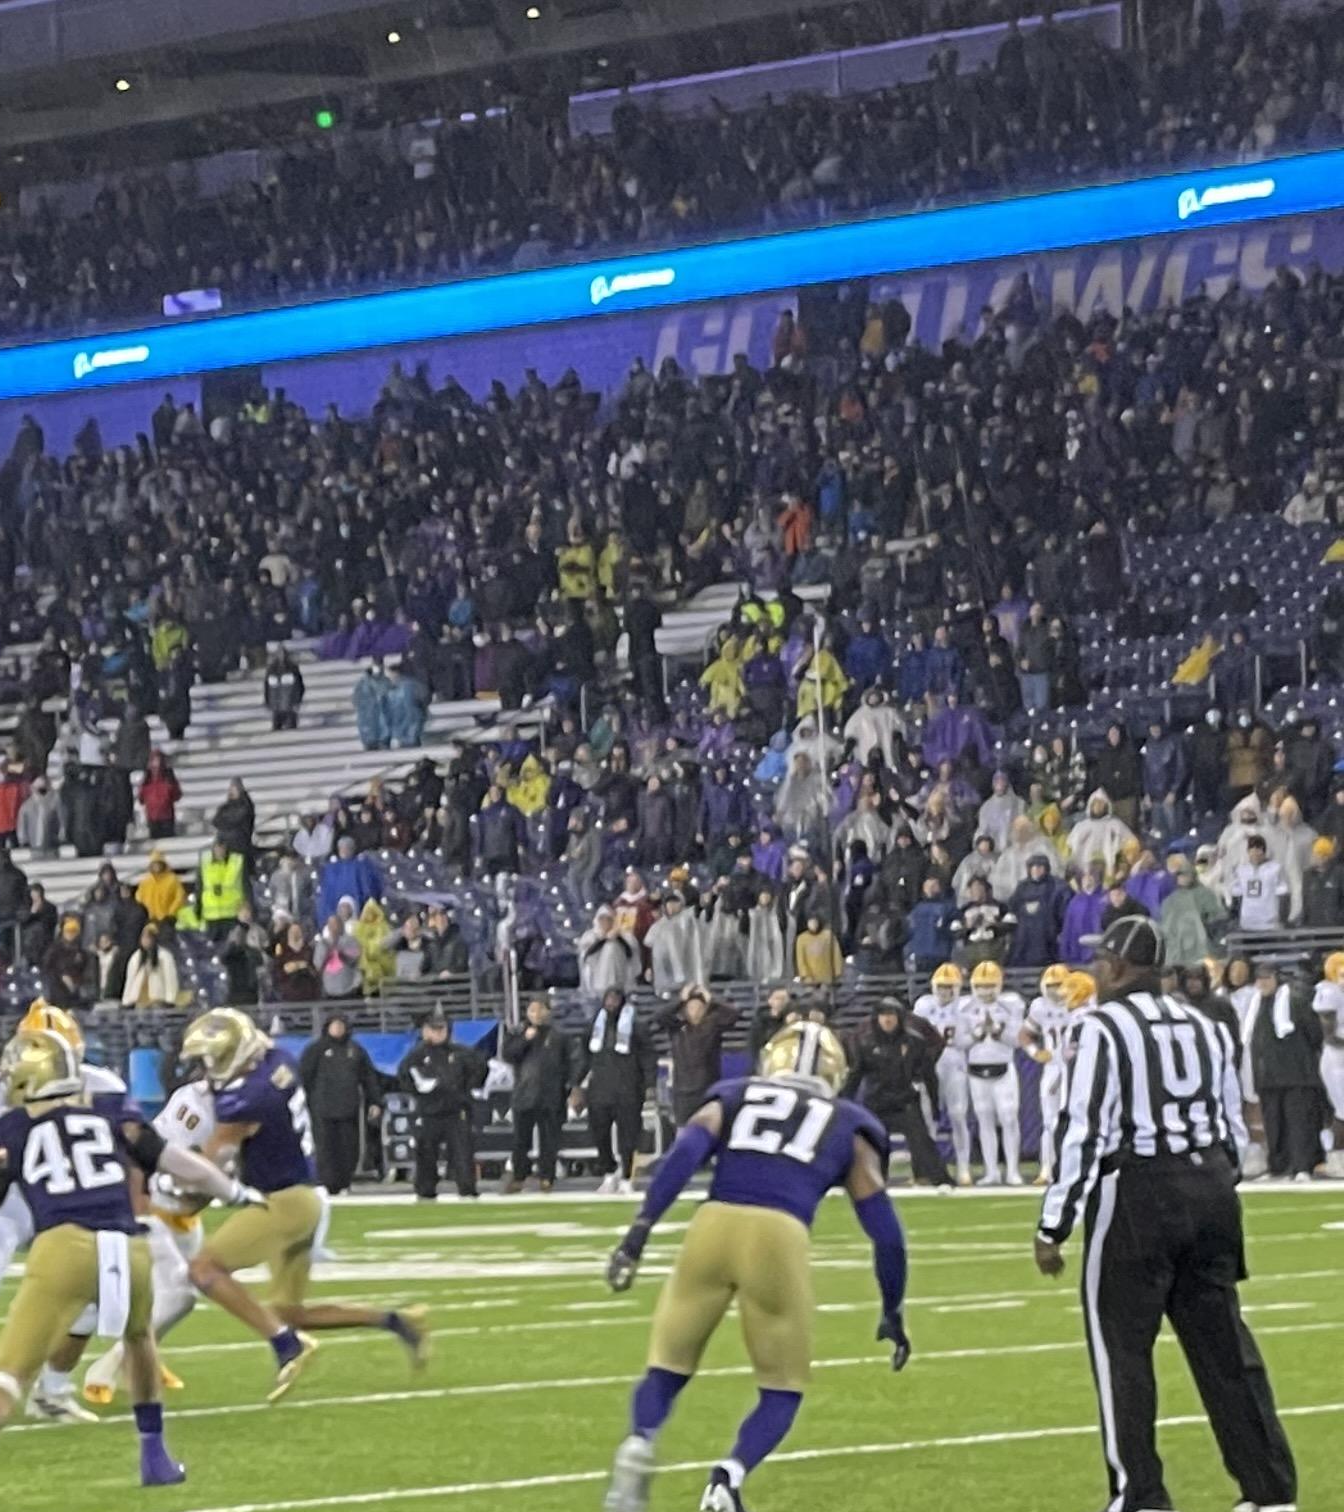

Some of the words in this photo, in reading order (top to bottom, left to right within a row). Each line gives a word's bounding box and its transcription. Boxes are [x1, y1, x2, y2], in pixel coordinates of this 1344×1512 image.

[1151, 1023, 1202, 1098] U
[22, 1113, 126, 1195] 42
[728, 1084, 834, 1164] 21
